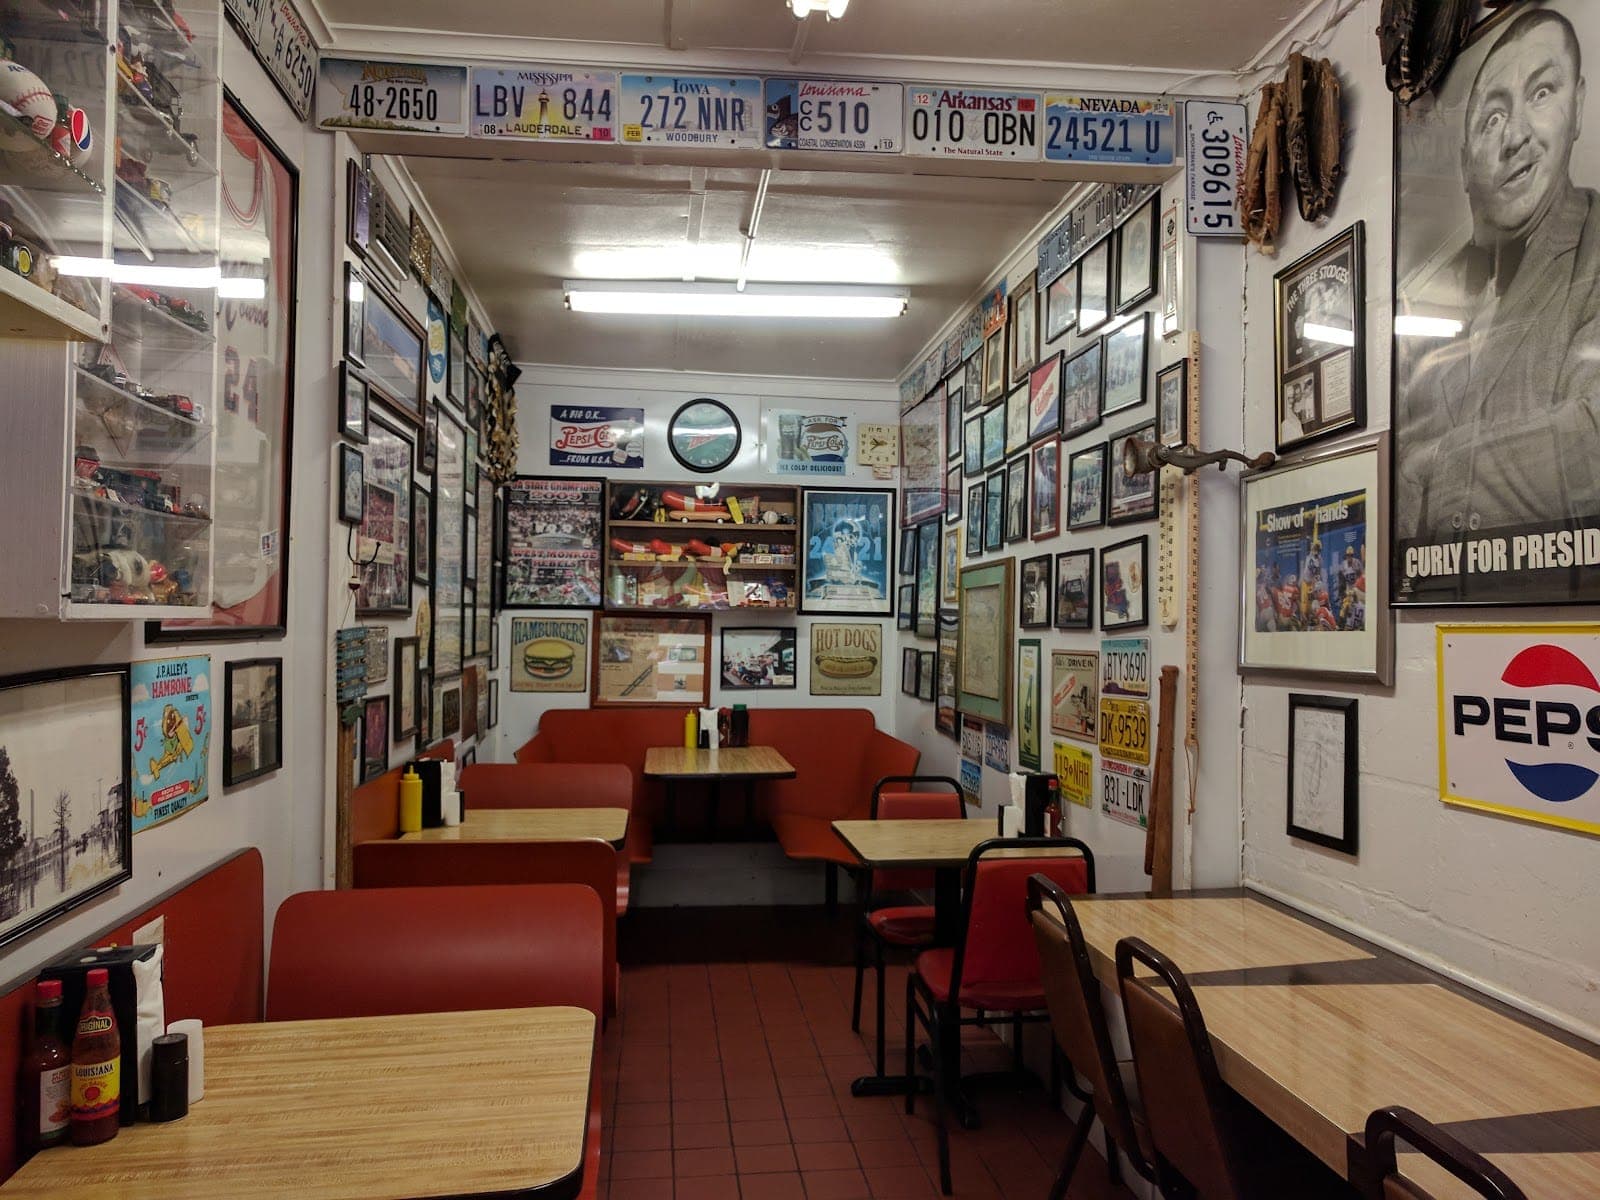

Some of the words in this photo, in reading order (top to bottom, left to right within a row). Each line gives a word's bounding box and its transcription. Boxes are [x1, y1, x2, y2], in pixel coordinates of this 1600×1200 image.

[517, 71, 573, 86] MISSISSIPPI
[800, 83, 870, 97] Louisiana
[917, 94, 929, 104] 12
[937, 90, 1012, 111] Arkansas
[476, 84, 524, 117] LBV
[563, 88, 611, 121] 844
[640, 95, 687, 129] 272
[698, 97, 744, 131] NNR
[1080, 98, 1140, 113] NEVADA
[817, 101, 869, 134] 510
[484, 124, 496, 134] 08
[506, 123, 582, 135] LAUDERDALE
[666, 132, 718, 142] WOODBURY
[1047, 116, 1132, 153] 24521
[1145, 120, 1160, 153] U
[958, 147, 984, 155] Natural
[986, 148, 1003, 156] State
[1202, 129, 1233, 228] 309615
[1287, 290, 1299, 312] THE
[1297, 270, 1319, 295] THREE
[1319, 264, 1349, 284] STOOGES
[1267, 513, 1291, 533] Show
[1295, 507, 1304, 527] of
[1315, 499, 1349, 524] hands
[1406, 543, 1462, 577] CURLY
[1467, 538, 1507, 573] FOR
[514, 621, 585, 646] HAMBURGERS
[816, 628, 840, 653] HOT
[844, 628, 877, 653] DOGS
[1107, 652, 1147, 682] BTY3690
[152, 677, 192, 699] HAMBONE
[154, 804, 170, 820] FINEST
[75, 1063, 114, 1078] LOUISIANA
